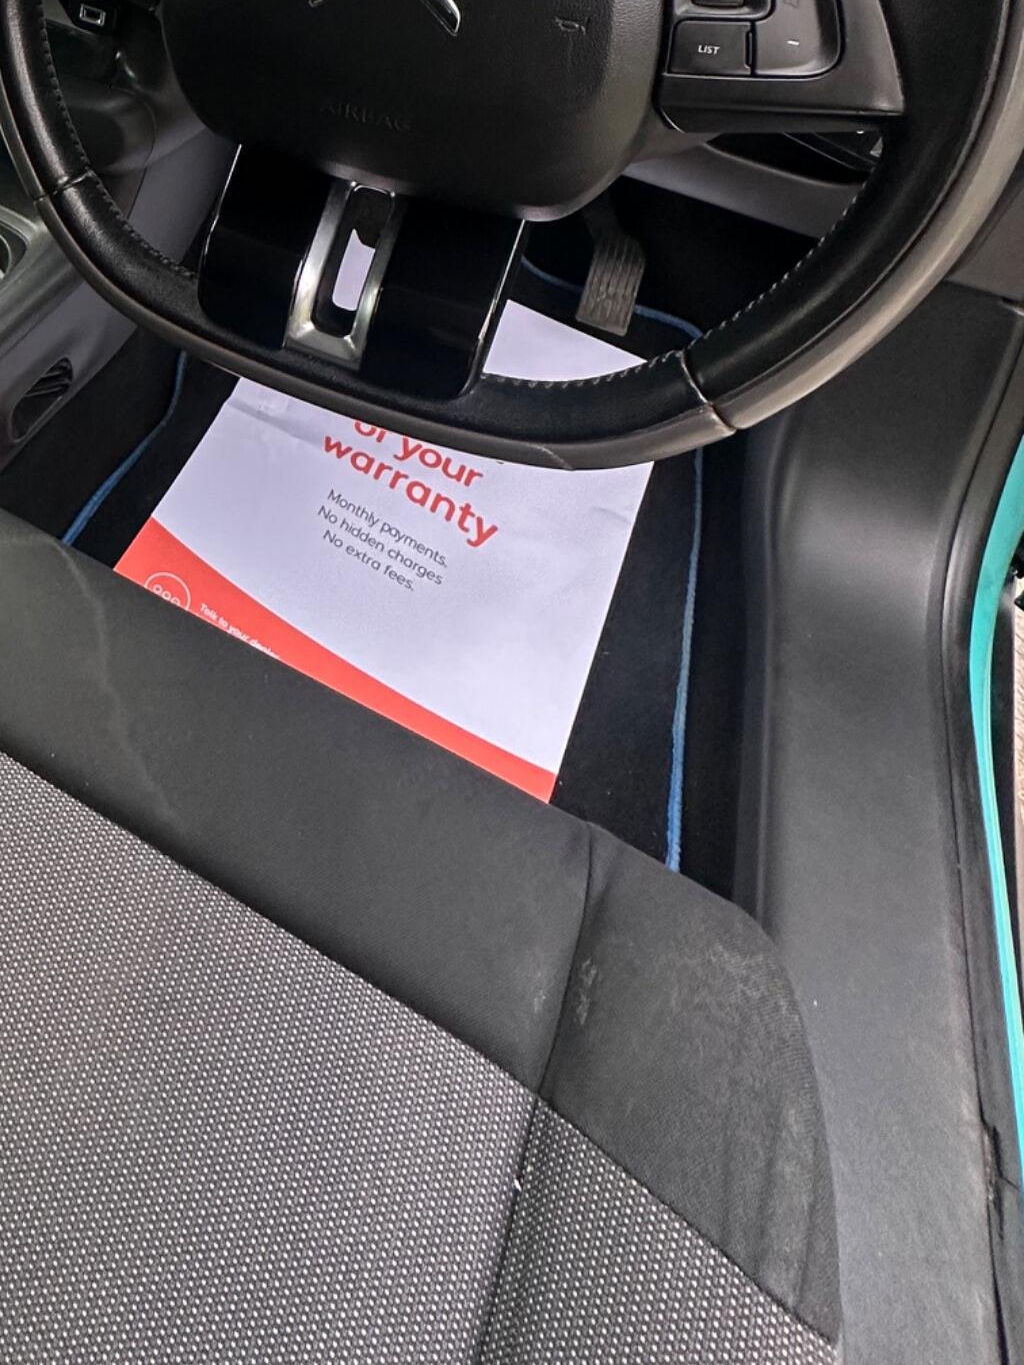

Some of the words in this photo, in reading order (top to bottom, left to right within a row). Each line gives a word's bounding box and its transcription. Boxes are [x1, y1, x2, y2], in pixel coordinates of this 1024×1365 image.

[697, 44, 720, 55] LIST
[324, 435, 498, 547] warranty
[393, 436, 483, 487] your
[317, 505, 338, 525] No
[340, 518, 385, 552] hidden
[387, 549, 443, 585] charges
[327, 489, 380, 527] Monthly
[380, 521, 448, 568] payments.
[322, 530, 344, 548] No
[345, 545, 381, 572] extra
[383, 565, 414, 592] fees.
[200, 603, 218, 621] Talk
[219, 616, 228, 629] to
[228, 625, 250, 643] your
